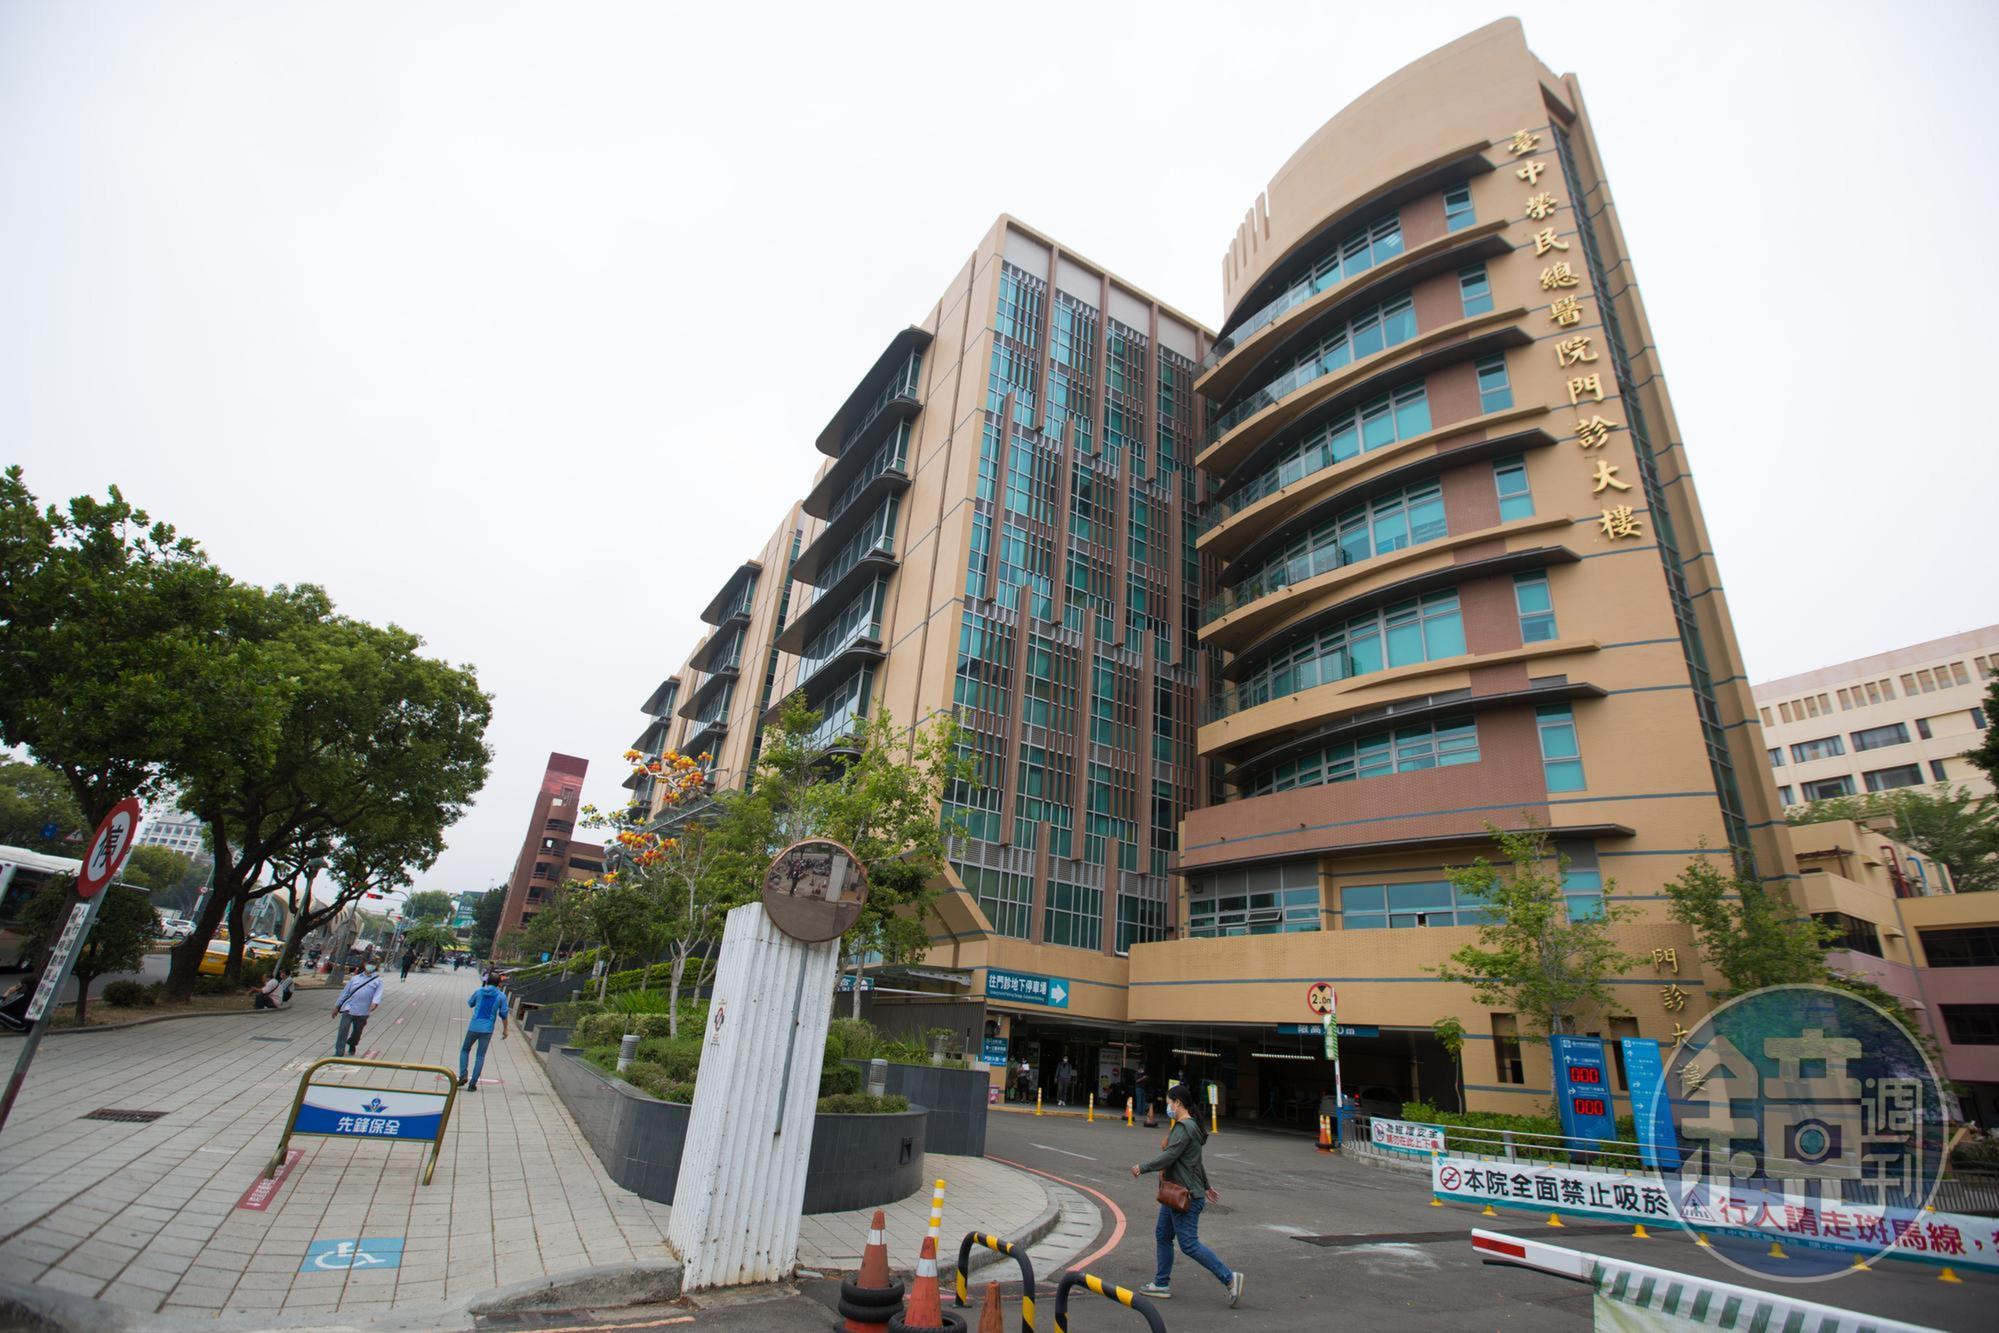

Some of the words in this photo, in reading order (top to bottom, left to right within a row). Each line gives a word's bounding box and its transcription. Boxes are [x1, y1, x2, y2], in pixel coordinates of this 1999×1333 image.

[1508, 128, 1643, 541] 臺中榮民總醫院門診大樓
[93, 824, 124, 868] 停
[988, 975, 1047, 995] 往門診地下停車場
[336, 1117, 401, 1135] 先鋒保全
[1464, 1168, 1670, 1216] 本院全面禁止吸菸
[1718, 1196, 1999, 1258] 行人請走斑馬線，
